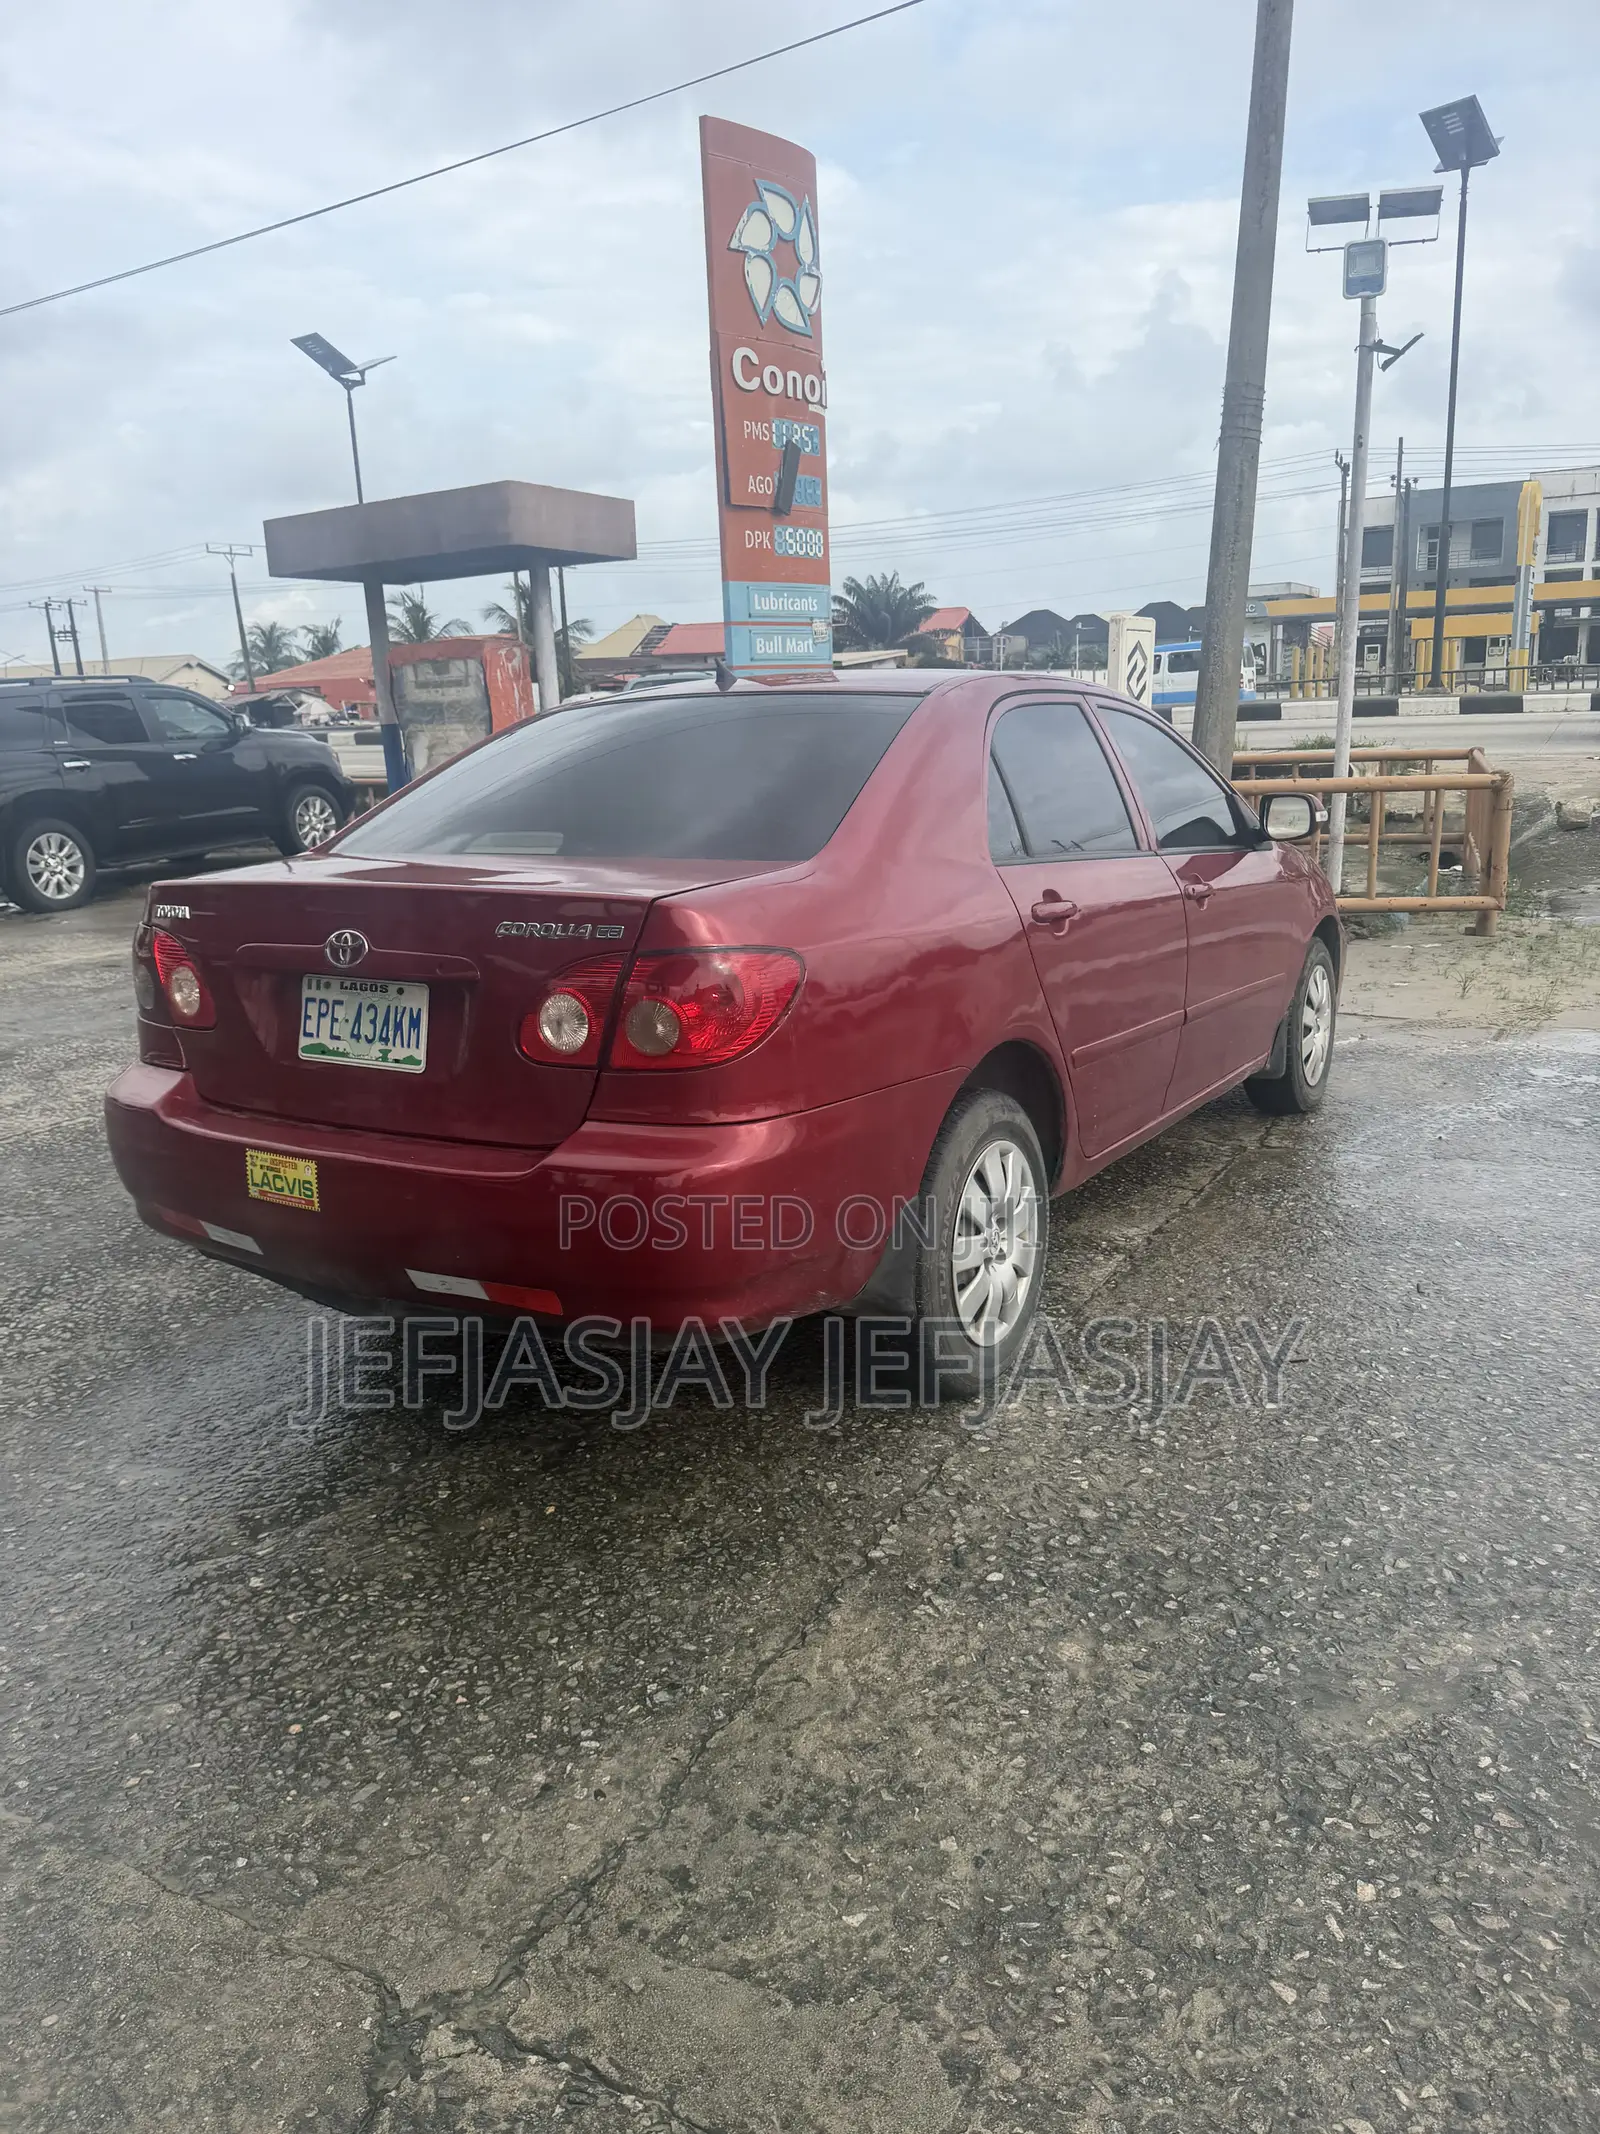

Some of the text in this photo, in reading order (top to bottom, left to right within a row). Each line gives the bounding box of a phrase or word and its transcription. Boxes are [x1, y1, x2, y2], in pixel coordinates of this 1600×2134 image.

[732, 346, 828, 408] Conoi
[743, 420, 770, 441] PMS
[748, 475, 773, 494] AGO
[745, 530, 772, 549] DPK
[754, 592, 818, 611] Lubricants
[756, 636, 814, 654] Bull Mart
[495, 921, 593, 939] COROLLA
[339, 981, 389, 993] LAGOS
[250, 1168, 314, 1199] LACVIS
